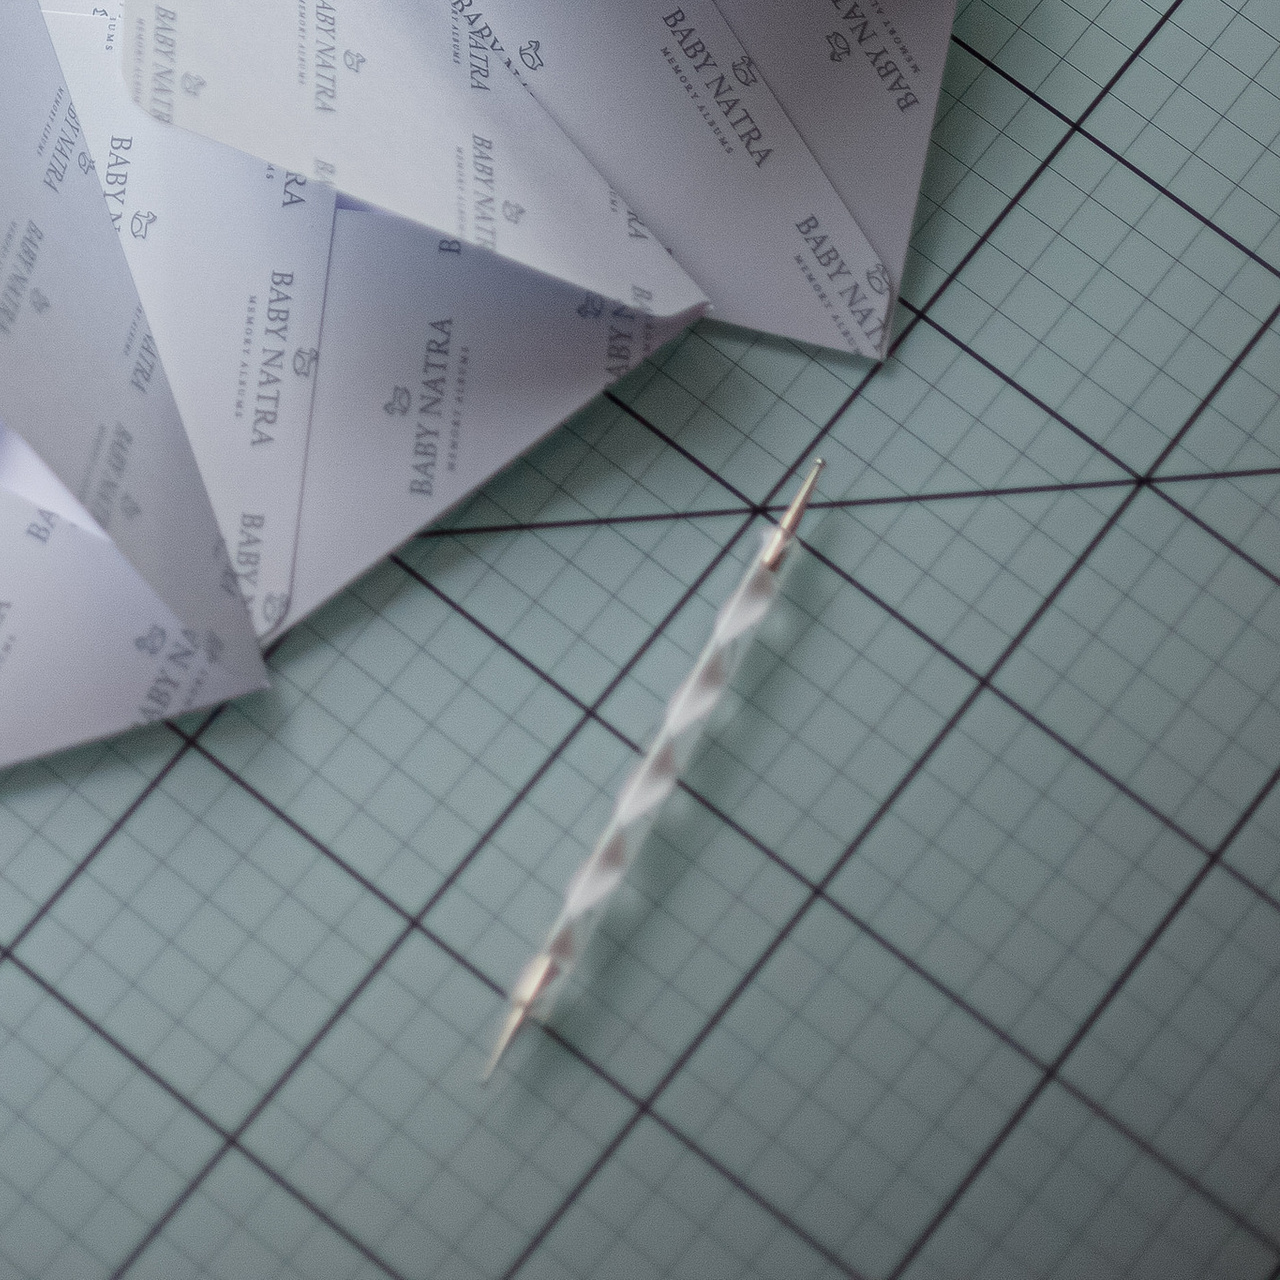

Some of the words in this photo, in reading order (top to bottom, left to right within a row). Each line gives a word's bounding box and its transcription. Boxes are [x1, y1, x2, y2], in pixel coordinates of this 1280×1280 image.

[315, 39, 337, 113] NATRA
[659, 46, 703, 101] MEMORY
[696, 103, 734, 155] ALBUMS
[662, 6, 719, 73] BABY
[704, 70, 774, 169] NATRA
[865, 43, 920, 114] BABY
[43, 126, 76, 194] NATRA
[104, 135, 133, 205] BABY
[472, 133, 495, 191] BABY
[795, 213, 852, 282] BABY
[265, 269, 295, 344] BABY
[250, 346, 286, 448] NATRA
[419, 316, 455, 417] NATRA
[408, 420, 441, 497] BABY
[235, 511, 265, 588] BABY
